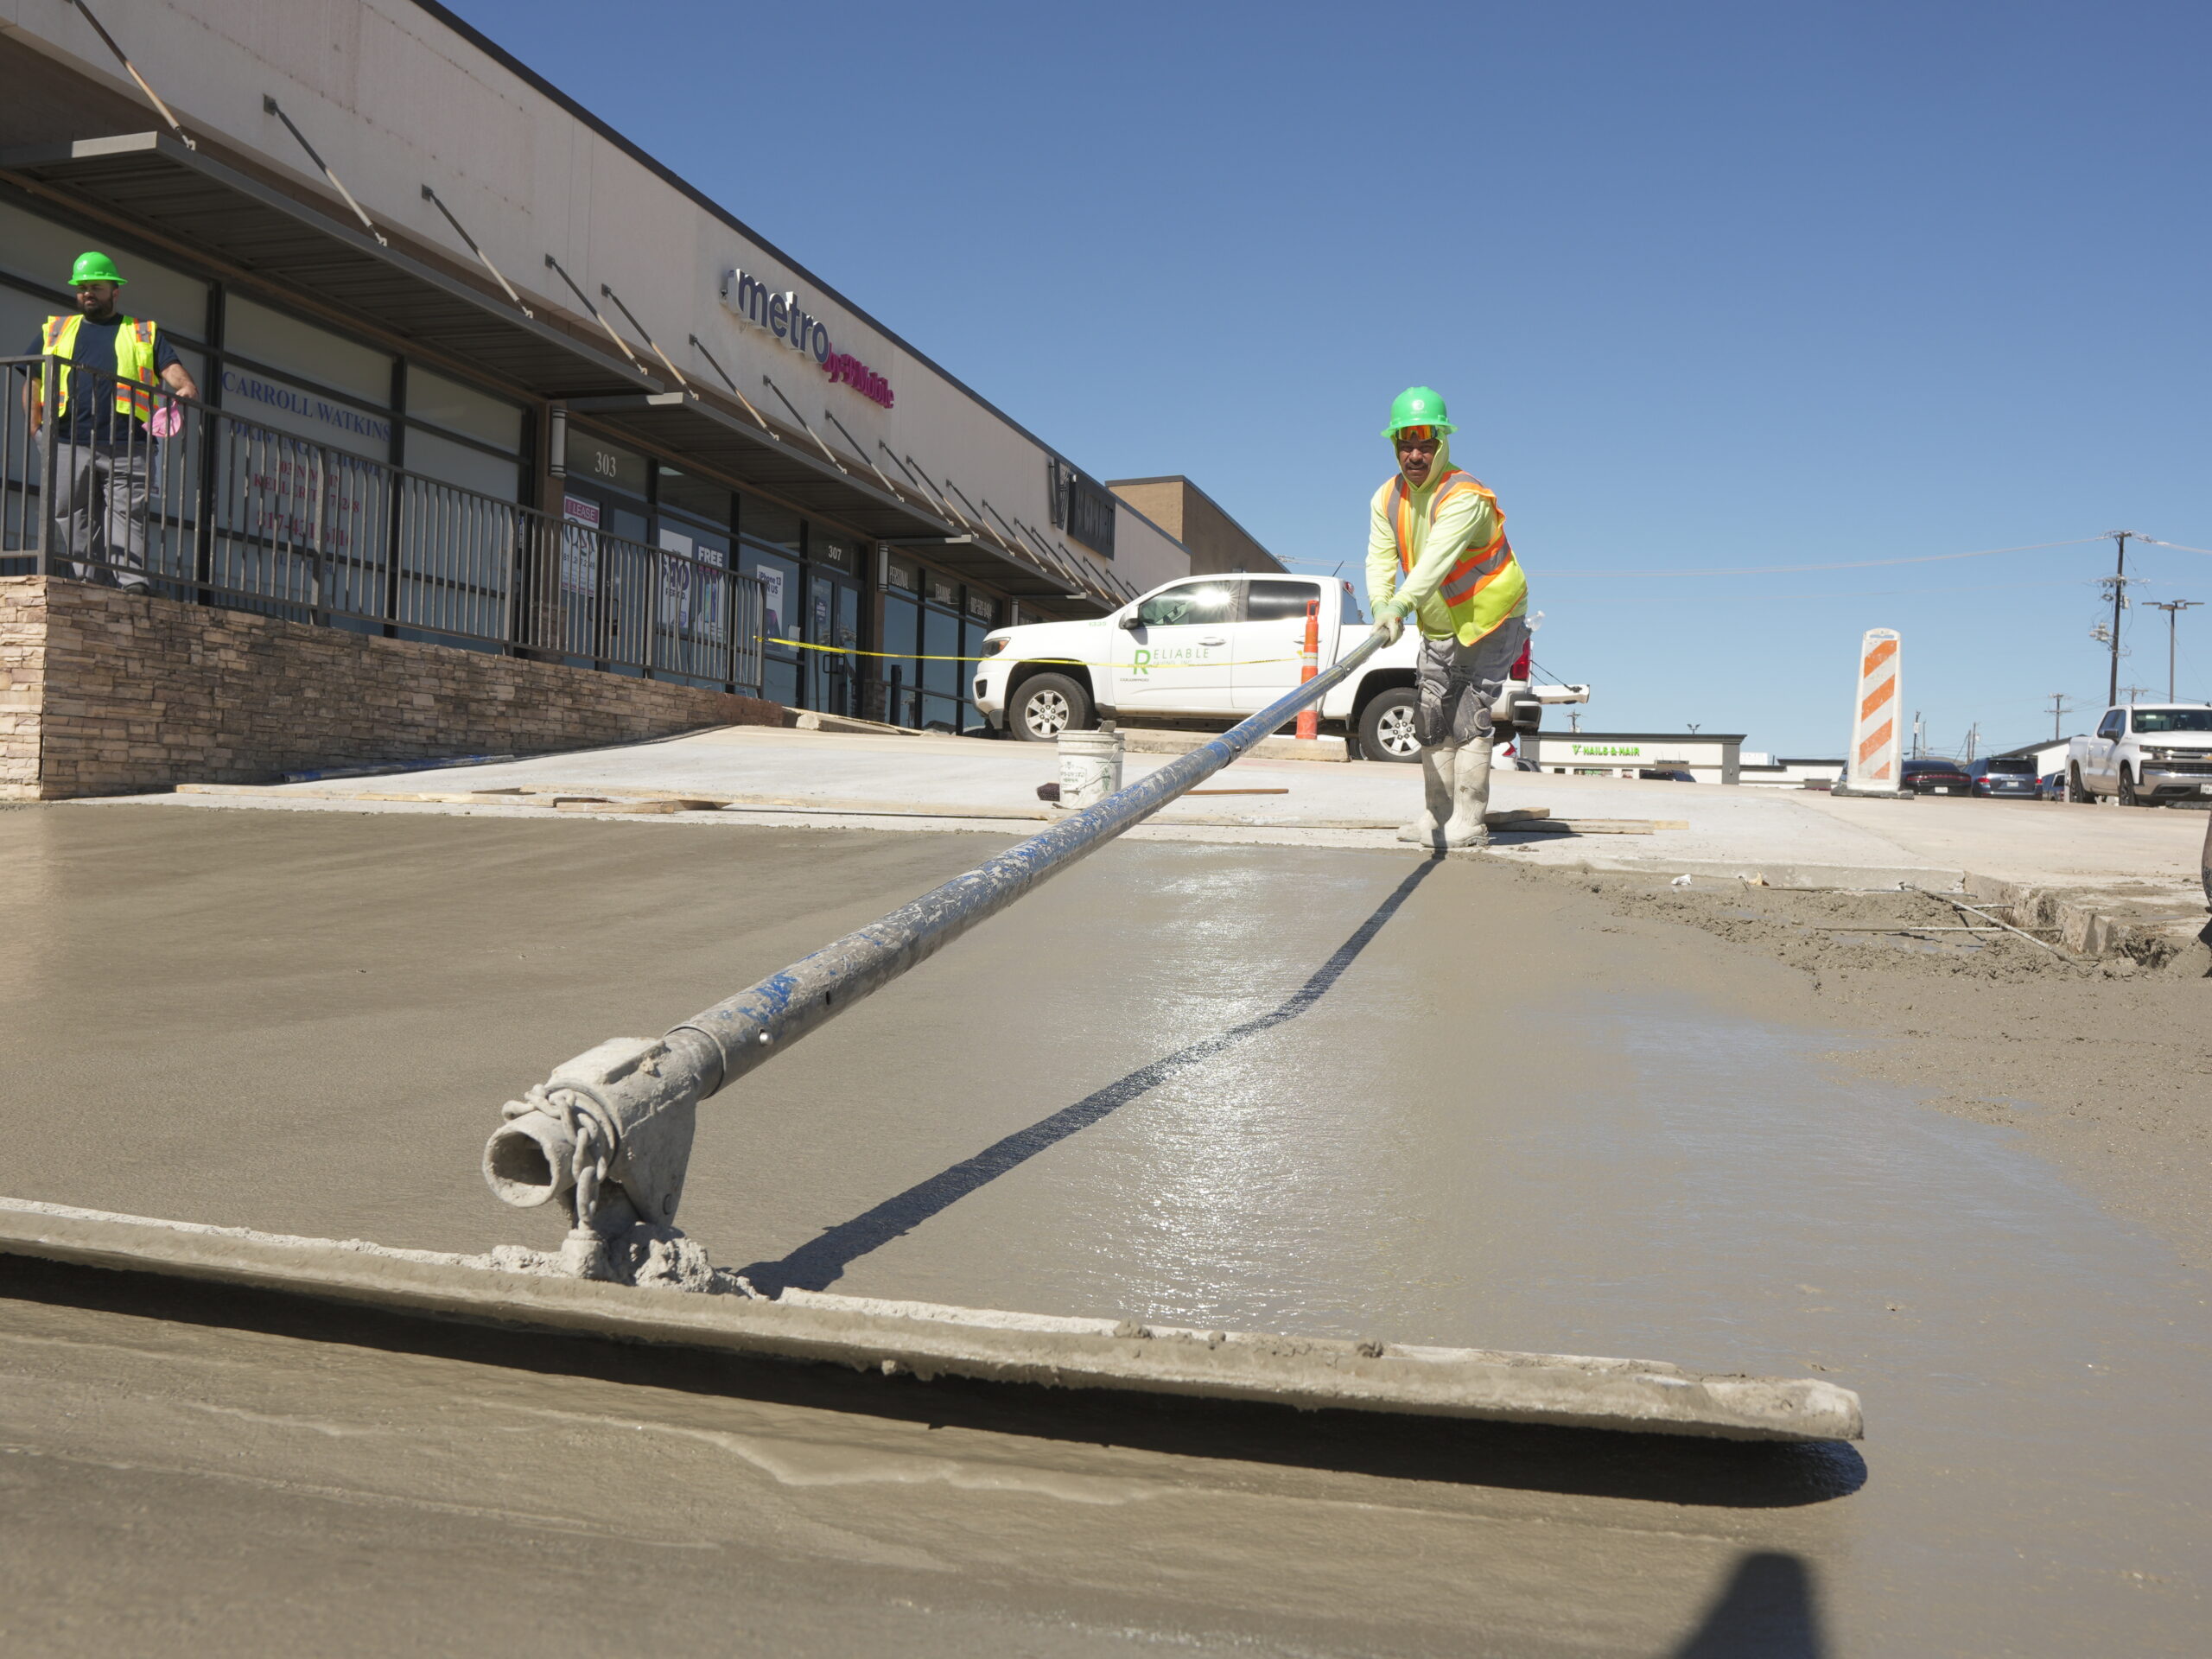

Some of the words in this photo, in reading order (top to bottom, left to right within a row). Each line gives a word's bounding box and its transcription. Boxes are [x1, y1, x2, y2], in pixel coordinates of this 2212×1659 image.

[732, 269, 829, 364] metro
[221, 372, 312, 418] CARROLL
[317, 402, 390, 443] WATKINS
[594, 451, 616, 477] 303
[572, 503, 595, 521] LEASE
[698, 545, 723, 568] FREE
[828, 545, 842, 561] 307
[1583, 747, 1608, 756] NAILS
[1618, 747, 1640, 757] HAIR
